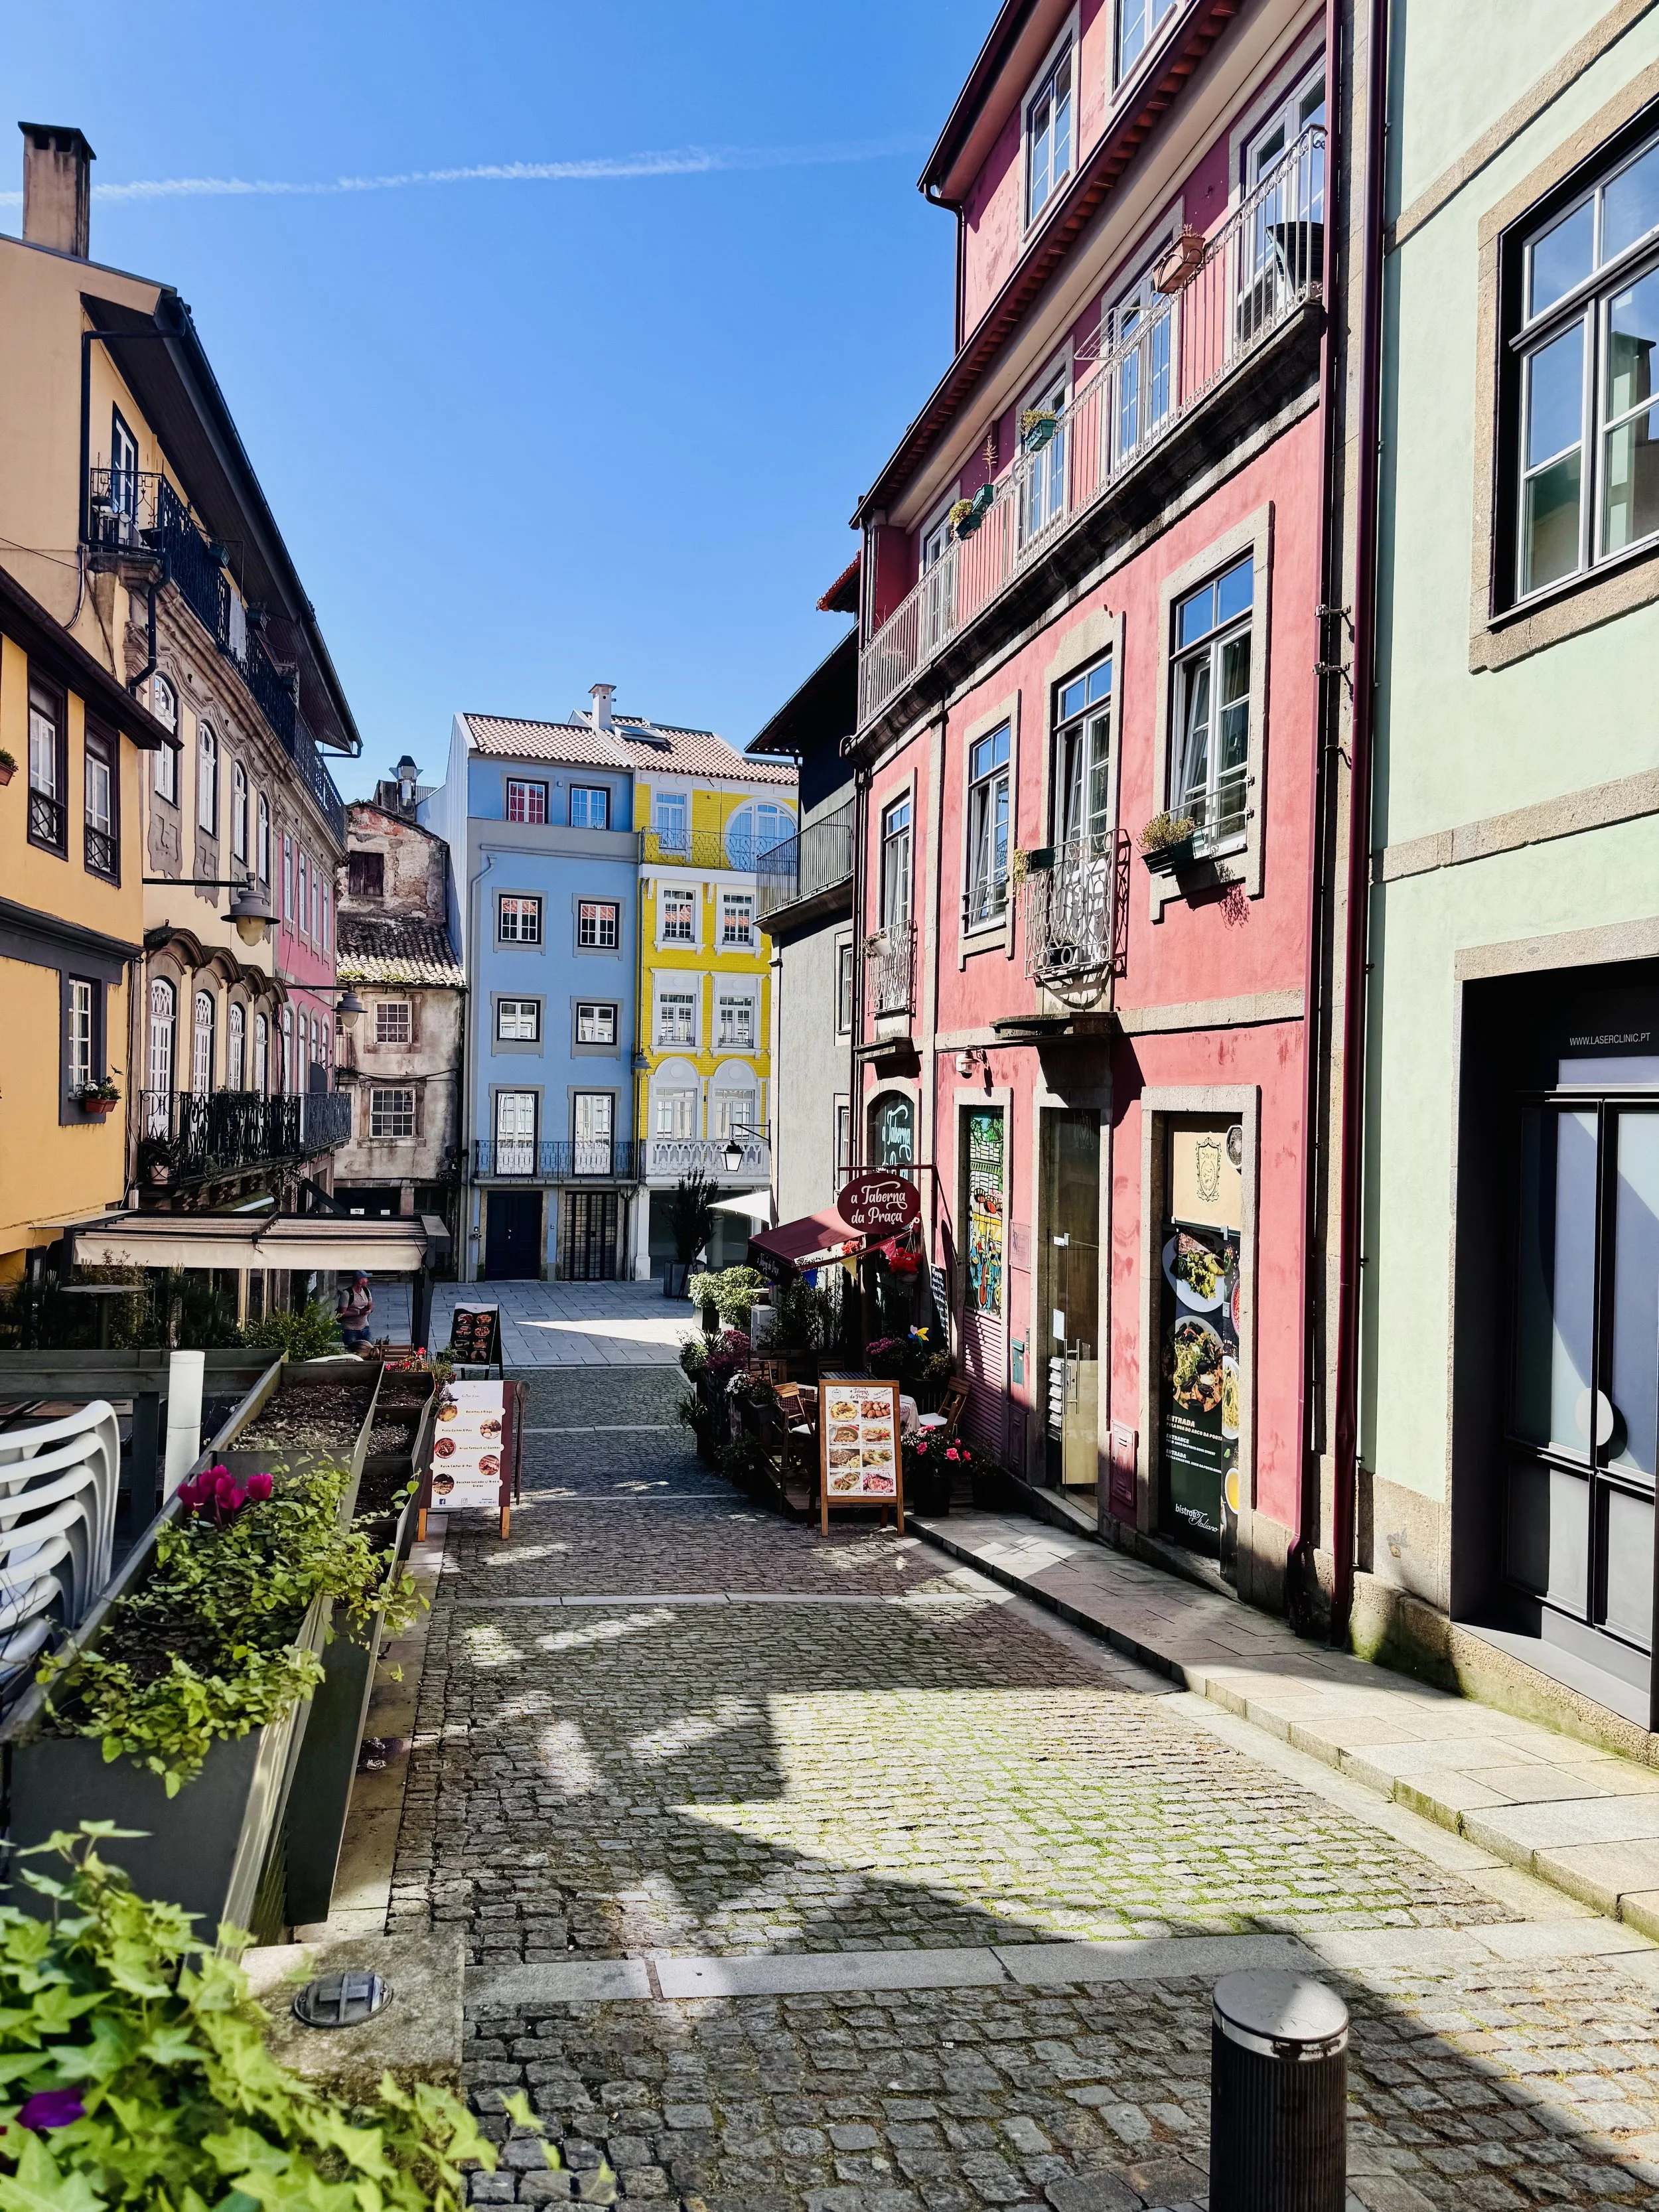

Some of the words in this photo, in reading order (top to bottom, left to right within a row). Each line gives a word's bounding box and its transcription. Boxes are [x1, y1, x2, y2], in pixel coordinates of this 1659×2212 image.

[1569, 1033, 1650, 1045] WWW.LASERCLINIC.PT
[887, 1105, 912, 1161] Taberna
[851, 1193, 858, 1204] a
[861, 1181, 908, 1210] Taberna
[851, 1209, 865, 1224] da
[868, 1207, 903, 1224] Praça
[1167, 1414, 1195, 1428] ENTRADA
[1166, 1434, 1189, 1443] ENTRANCE
[1166, 1449, 1187, 1459] ENTRADA
[1175, 1503, 1196, 1518] bistrot
